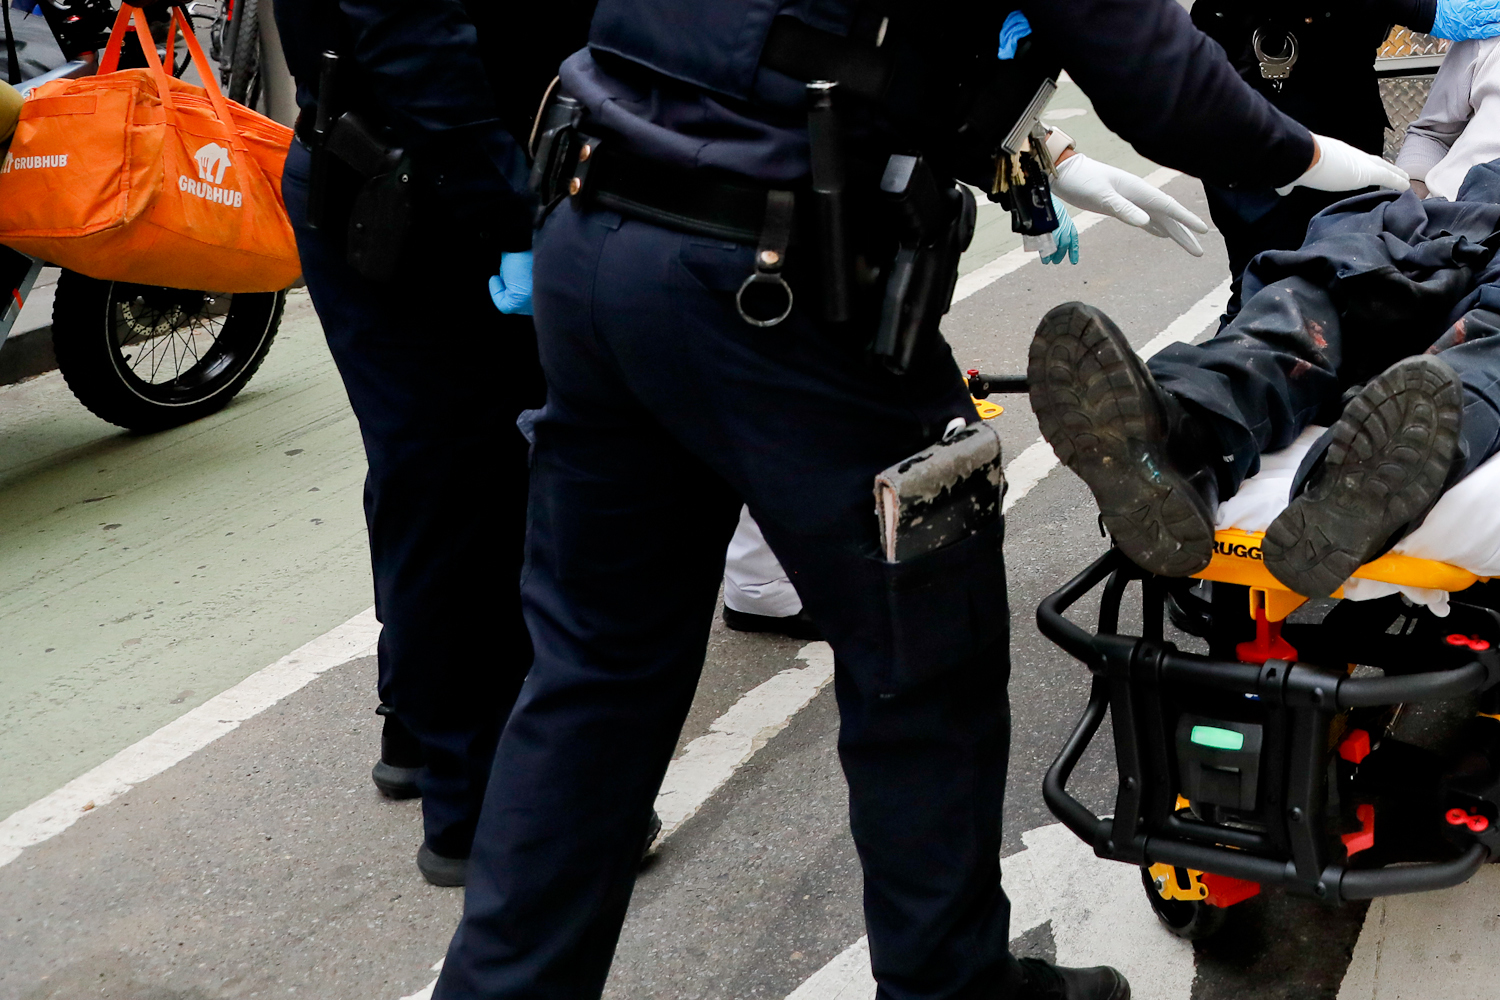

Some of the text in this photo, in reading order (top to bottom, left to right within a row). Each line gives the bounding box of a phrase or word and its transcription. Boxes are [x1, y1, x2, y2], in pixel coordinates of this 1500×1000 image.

[14, 154, 67, 170] GRUBHUB
[178, 174, 242, 208] GRUBHUB
[1213, 541, 1263, 560] RUGG
